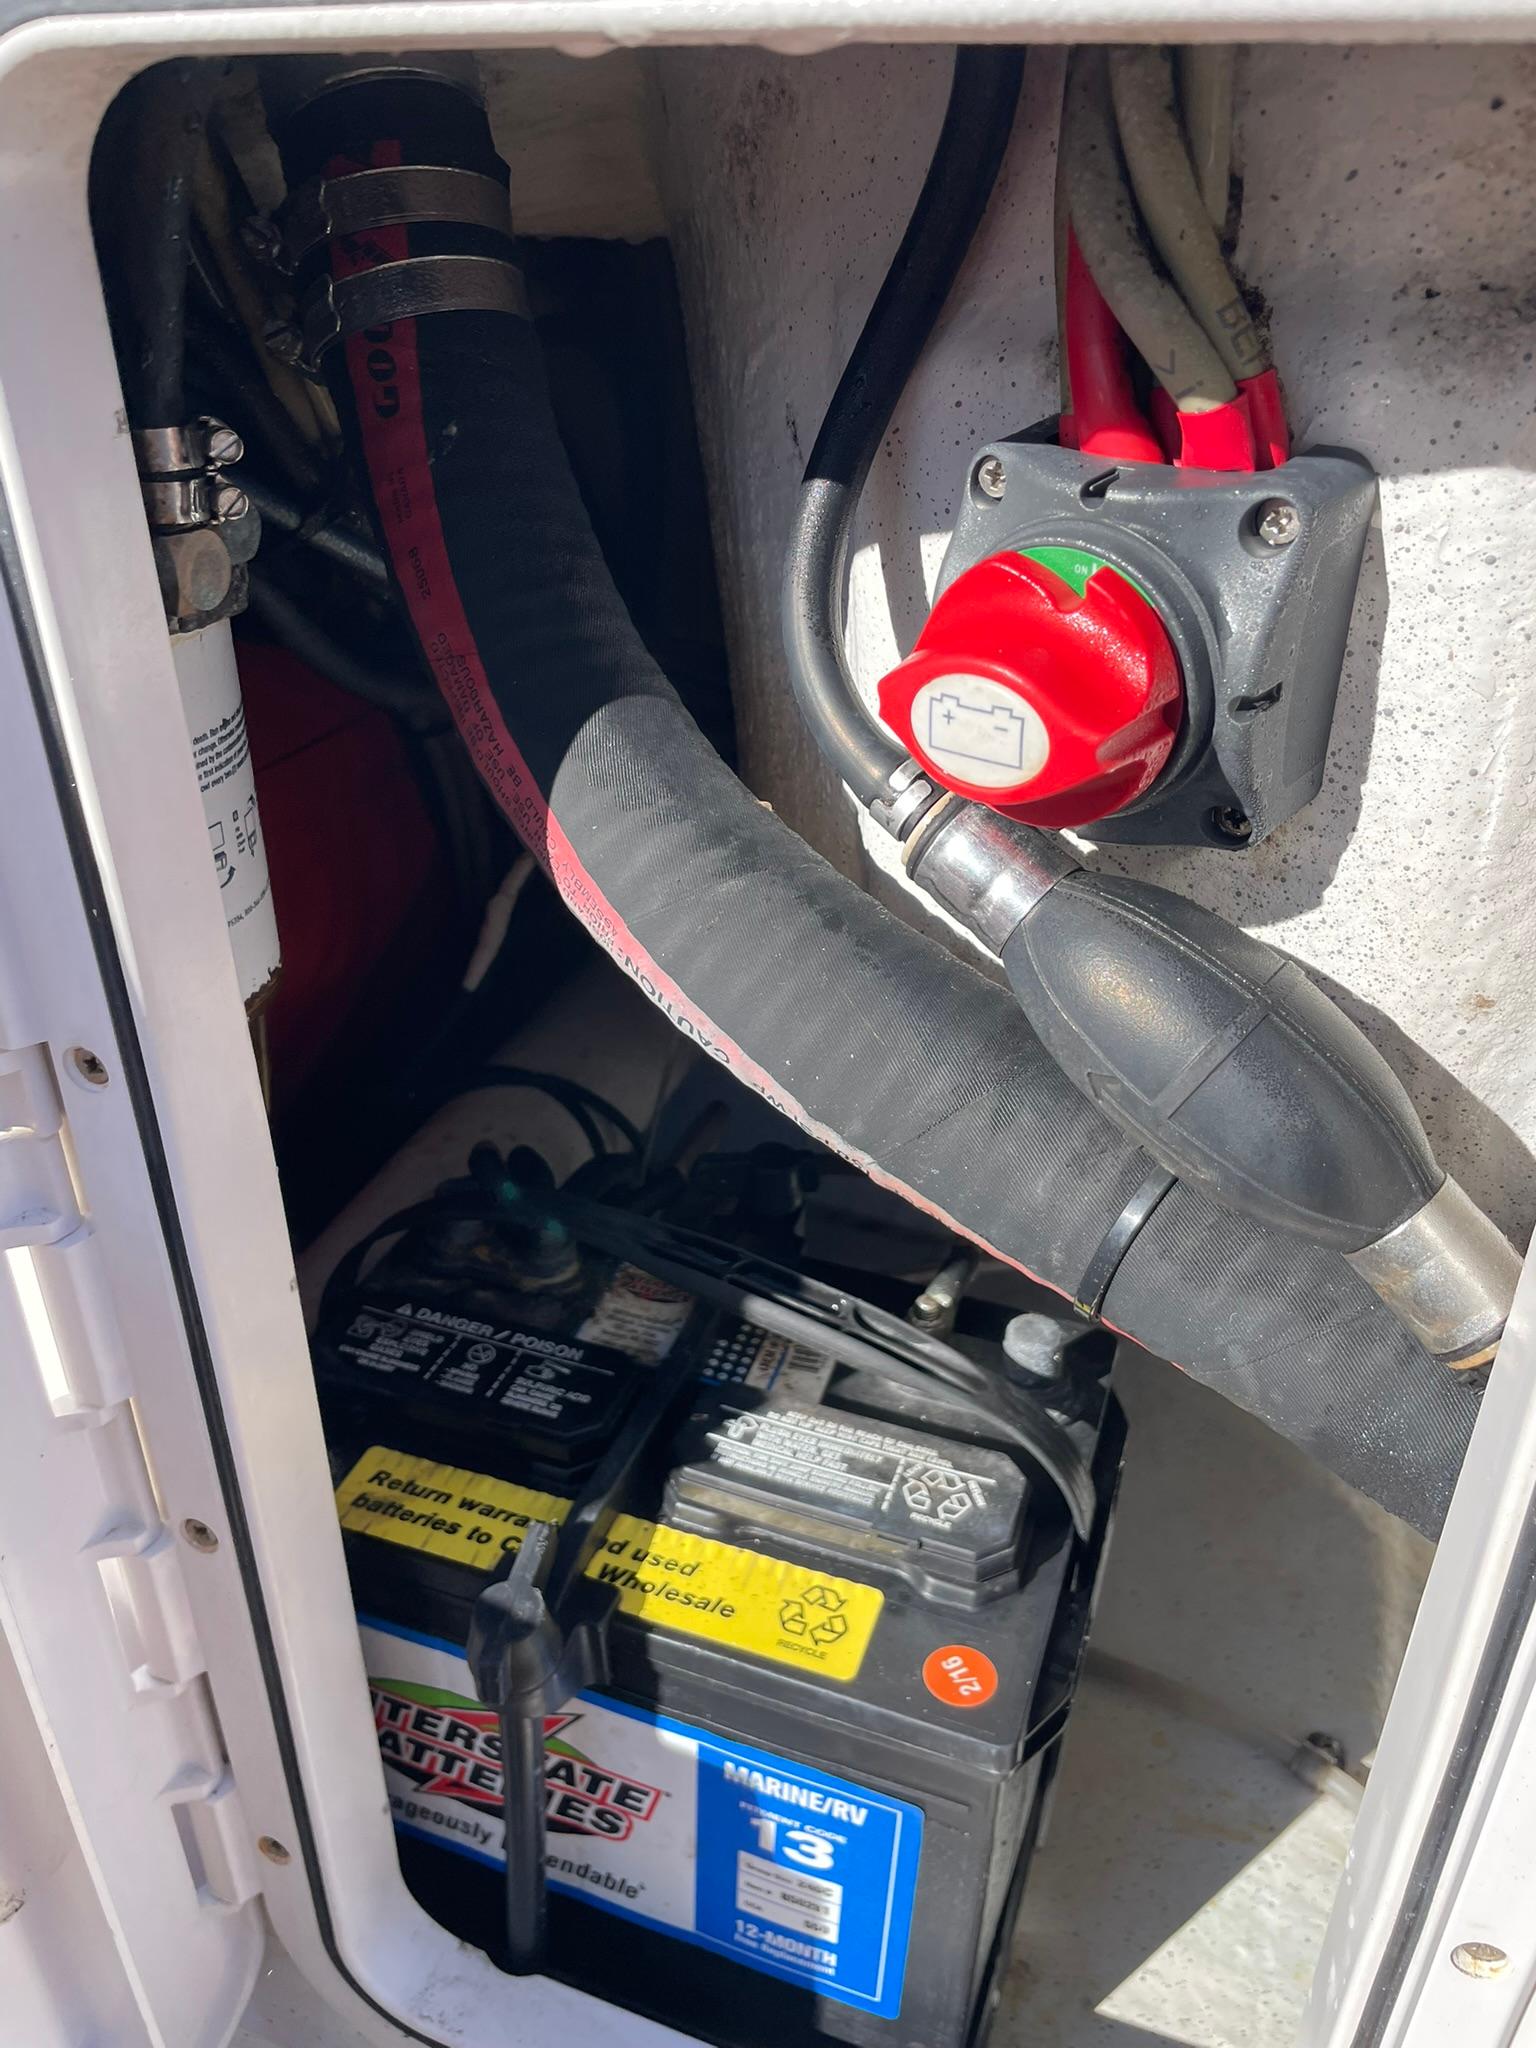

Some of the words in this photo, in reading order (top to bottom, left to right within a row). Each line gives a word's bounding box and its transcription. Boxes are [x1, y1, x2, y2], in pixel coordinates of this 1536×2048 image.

[1073, 562, 1089, 576] ON
[454, 655, 505, 756] HAZARDOUS
[506, 765, 523, 787] BE
[523, 797, 557, 850] COULD
[561, 876, 577, 897] TO
[562, 863, 617, 936] ASSEMBLY
[415, 1307, 493, 1339] DANGER
[508, 1331, 585, 1361] POISON
[368, 1470, 452, 1505] Return
[631, 1547, 701, 1578] used
[351, 1494, 458, 1535] batteries
[465, 1525, 493, 1545] to
[599, 1562, 736, 1619] Wholesale
[776, 1638, 828, 1661] RECYCLE
[940, 1655, 980, 1697] 2/16
[723, 1761, 868, 1828] MARINE/RV
[750, 1817, 836, 1870] 13
[802, 1824, 848, 1844] CODE
[735, 1919, 838, 1965] 12-MONTH
